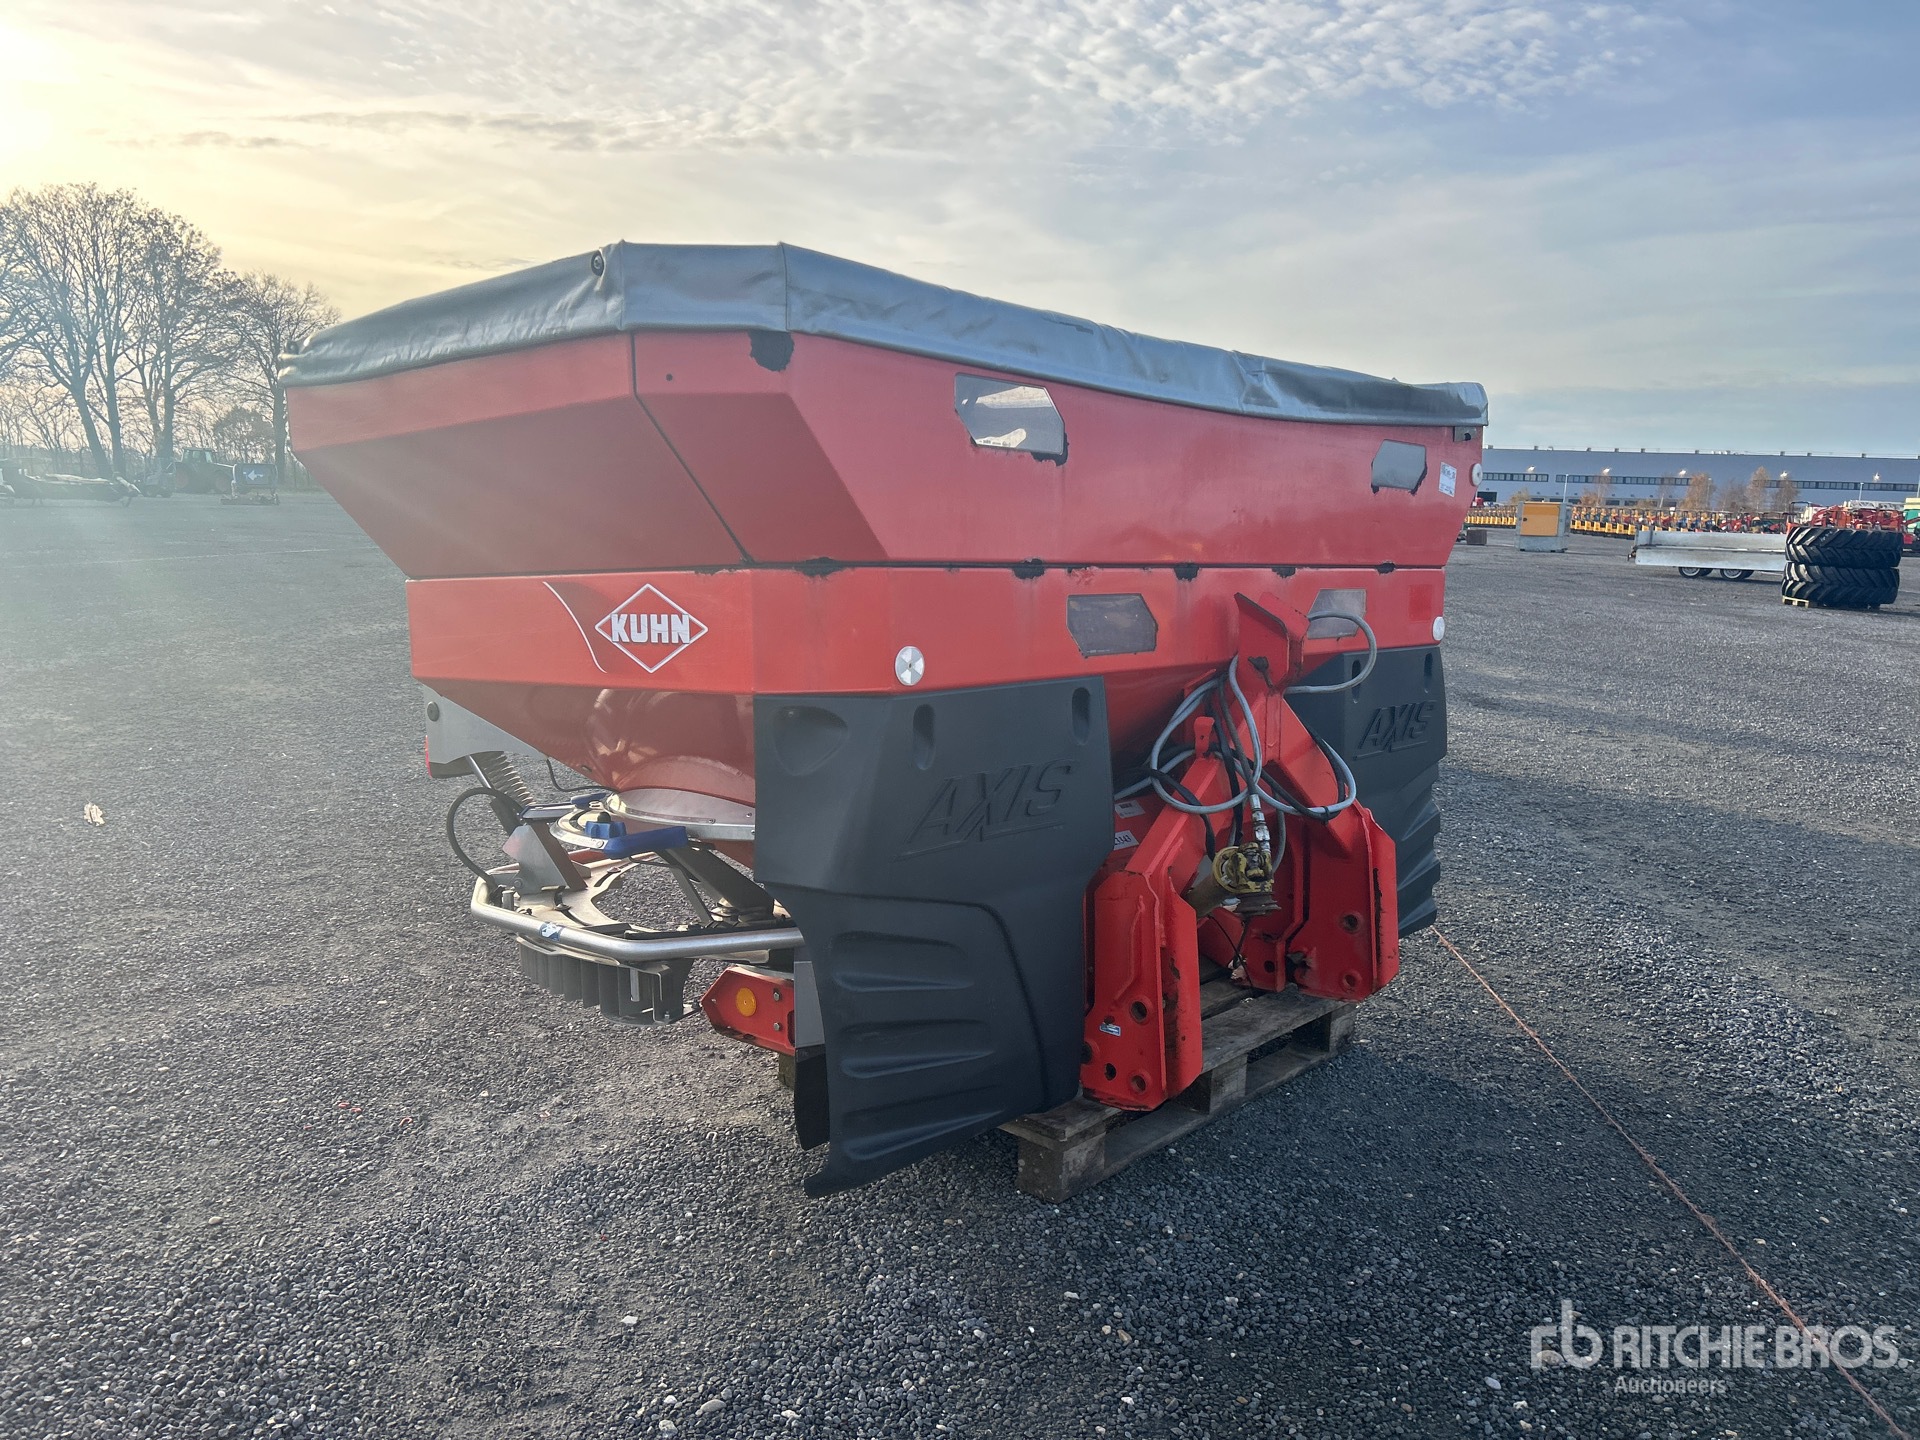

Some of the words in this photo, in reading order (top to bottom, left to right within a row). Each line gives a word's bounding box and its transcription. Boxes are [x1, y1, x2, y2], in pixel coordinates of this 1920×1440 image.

[610, 613, 690, 644] KUHN
[1357, 700, 1437, 752] AXIS
[904, 758, 1075, 843] AXIS
